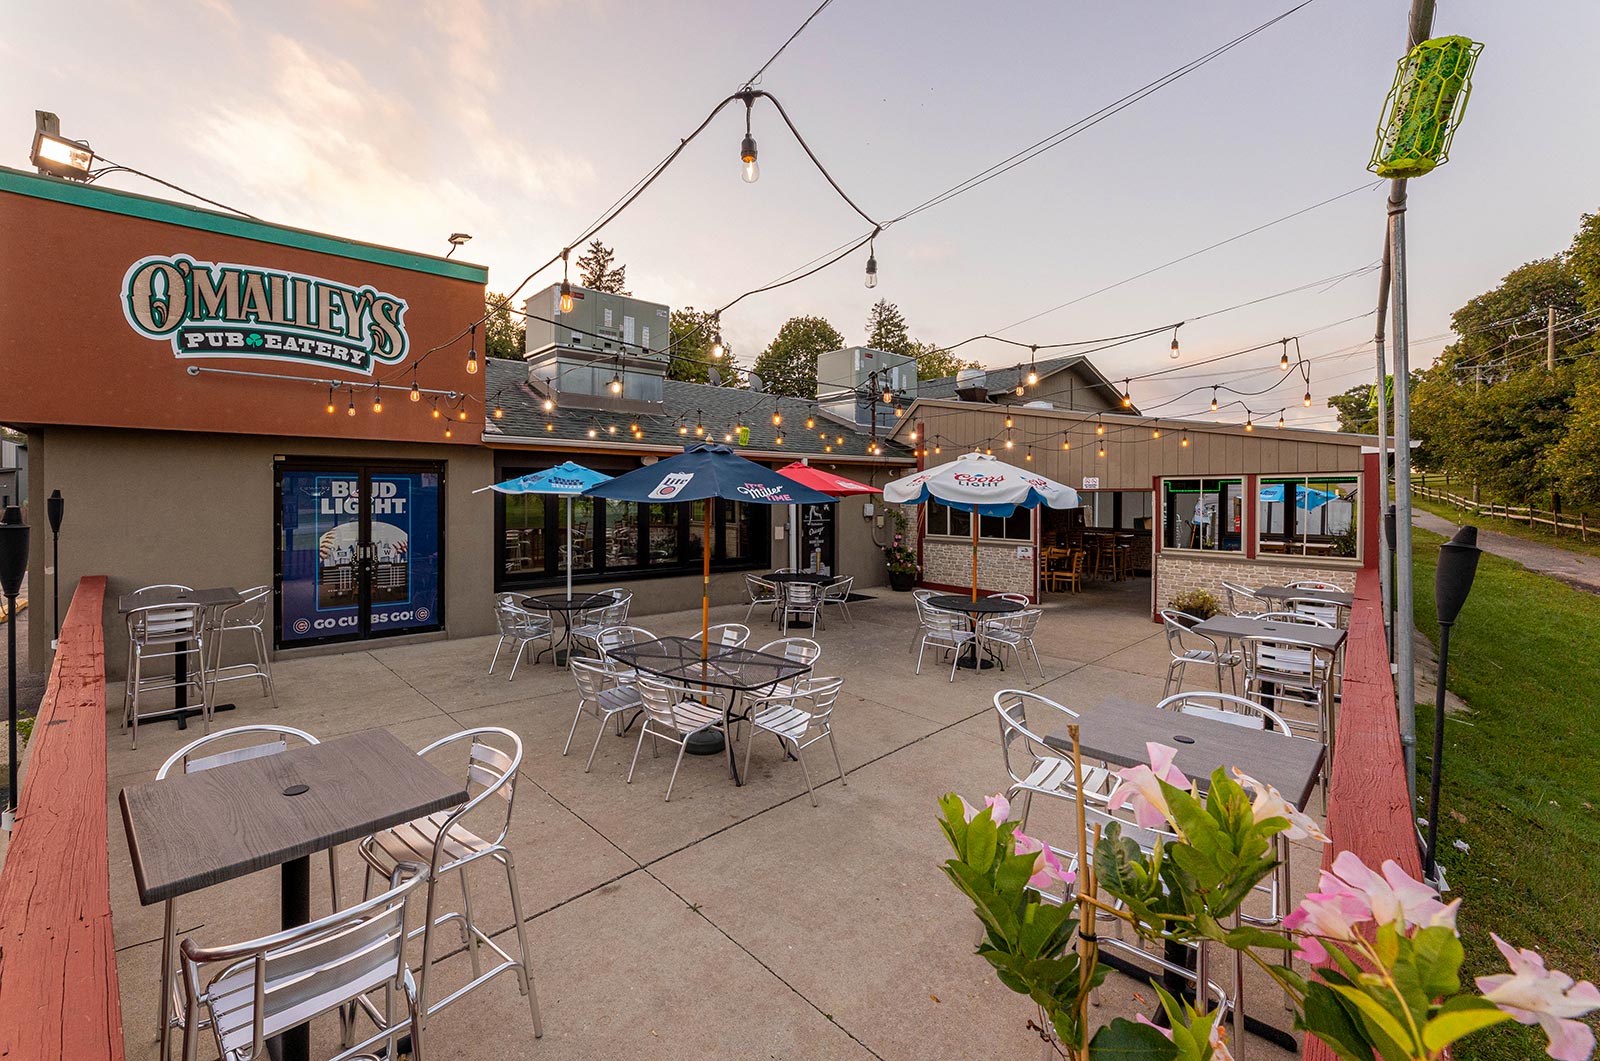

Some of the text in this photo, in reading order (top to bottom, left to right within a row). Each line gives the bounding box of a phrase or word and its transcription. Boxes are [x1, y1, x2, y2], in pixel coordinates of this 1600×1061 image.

[129, 259, 402, 358] O'MALLEY'S
[184, 332, 366, 364] PUB EATERY
[954, 472, 1005, 483] Coors
[332, 481, 397, 497] BUD
[737, 485, 783, 499] Miller
[314, 618, 336, 629] GO
[338, 613, 389, 627] CUBS
[390, 611, 413, 622] GO!
